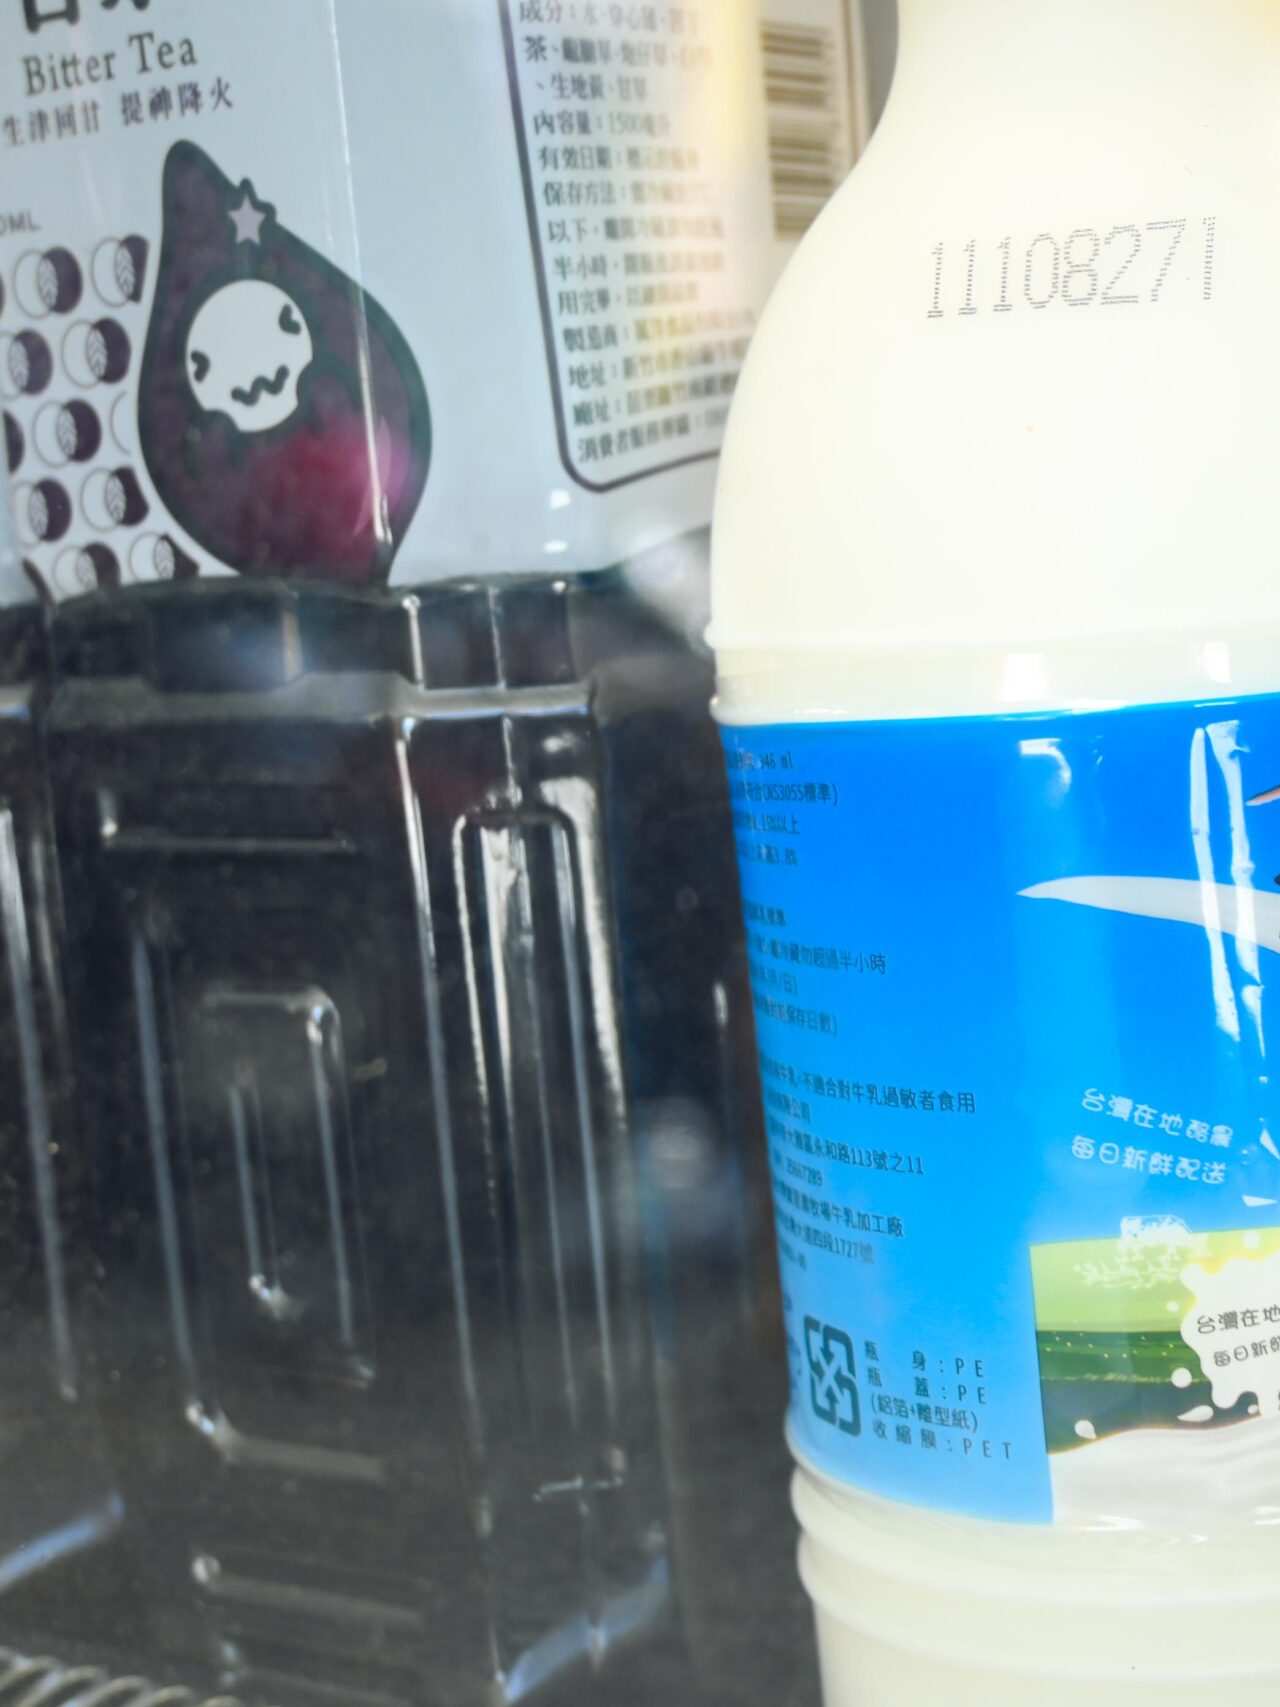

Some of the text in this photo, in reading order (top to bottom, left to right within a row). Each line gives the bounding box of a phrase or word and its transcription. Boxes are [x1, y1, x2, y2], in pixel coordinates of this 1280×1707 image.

[22, 31, 197, 96] Bitter Tea
[1071, 1134, 1228, 1185] 每日新鮮配送
